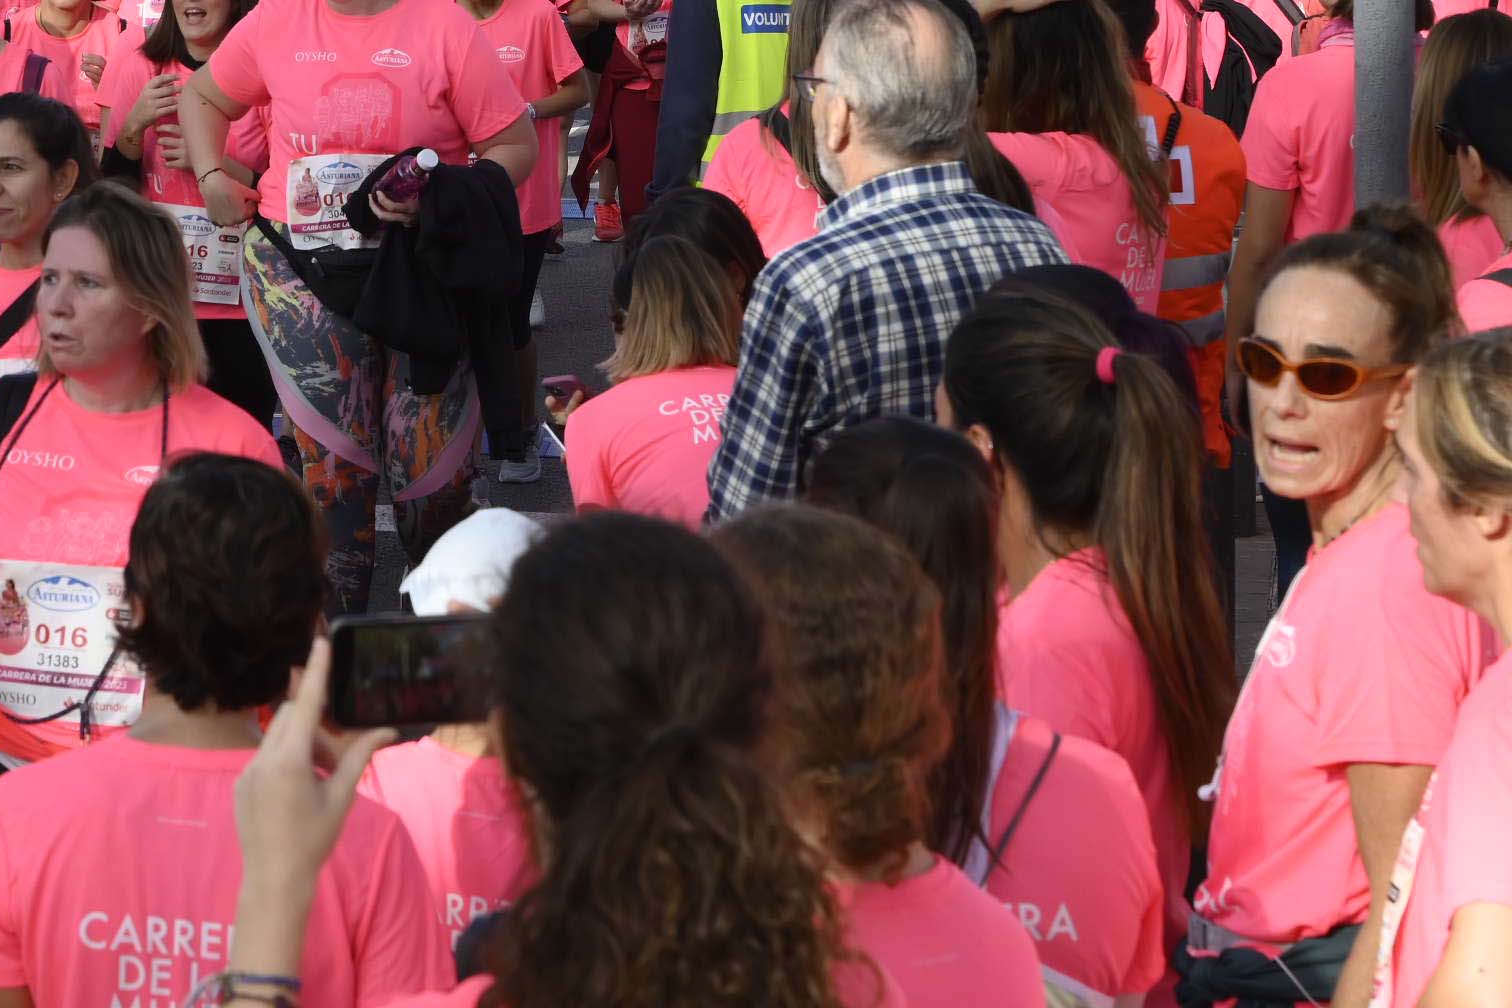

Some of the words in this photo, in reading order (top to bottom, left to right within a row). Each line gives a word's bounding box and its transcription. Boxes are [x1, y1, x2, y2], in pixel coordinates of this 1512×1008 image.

[295, 50, 337, 63] OYSHO
[375, 55, 409, 65] ASTURIANA
[289, 132, 318, 154] TU
[320, 169, 360, 181] ASTURIANA
[187, 244, 208, 258] 16
[1126, 246, 1145, 269] DE
[7, 448, 75, 471] OYSHO
[32, 586, 96, 605] ASTURIANA
[35, 624, 88, 648] 016
[37, 653, 80, 669] 31383
[38, 673, 52, 684] DE
[53, 674, 66, 685] LA
[118, 955, 172, 996] DE
